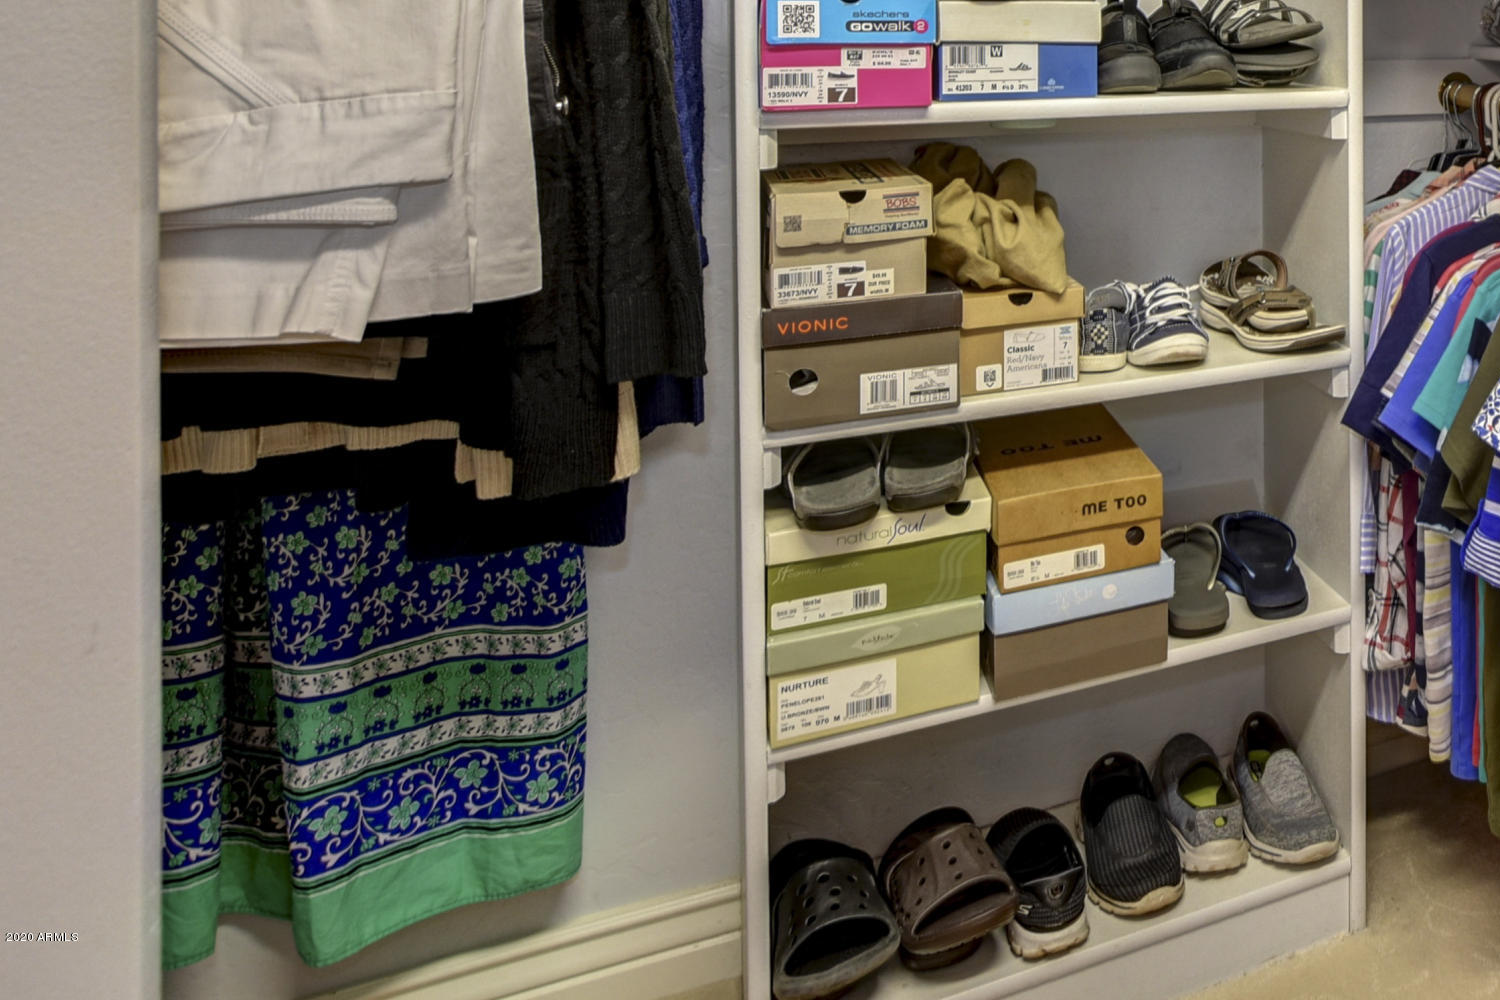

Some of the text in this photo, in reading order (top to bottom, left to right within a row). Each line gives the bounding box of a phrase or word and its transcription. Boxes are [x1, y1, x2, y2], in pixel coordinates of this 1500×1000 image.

[852, 10, 910, 19] skechers
[850, 20, 926, 32] GOwalk 2
[991, 46, 1002, 56] W
[768, 91, 808, 99] 13590/NVY
[835, 88, 848, 102] 7
[886, 197, 917, 208] BOBS
[850, 220, 925, 235] MEMORY FOAM
[844, 282, 857, 297] 7
[777, 317, 849, 336] VIONIC
[1007, 344, 1035, 353] Classic
[1007, 354, 1044, 364] Red/Navy
[1006, 362, 1047, 373] Americana
[867, 373, 897, 381] VIONIC
[1081, 494, 1147, 516] ME TOO
[780, 676, 829, 694] NURTURE
